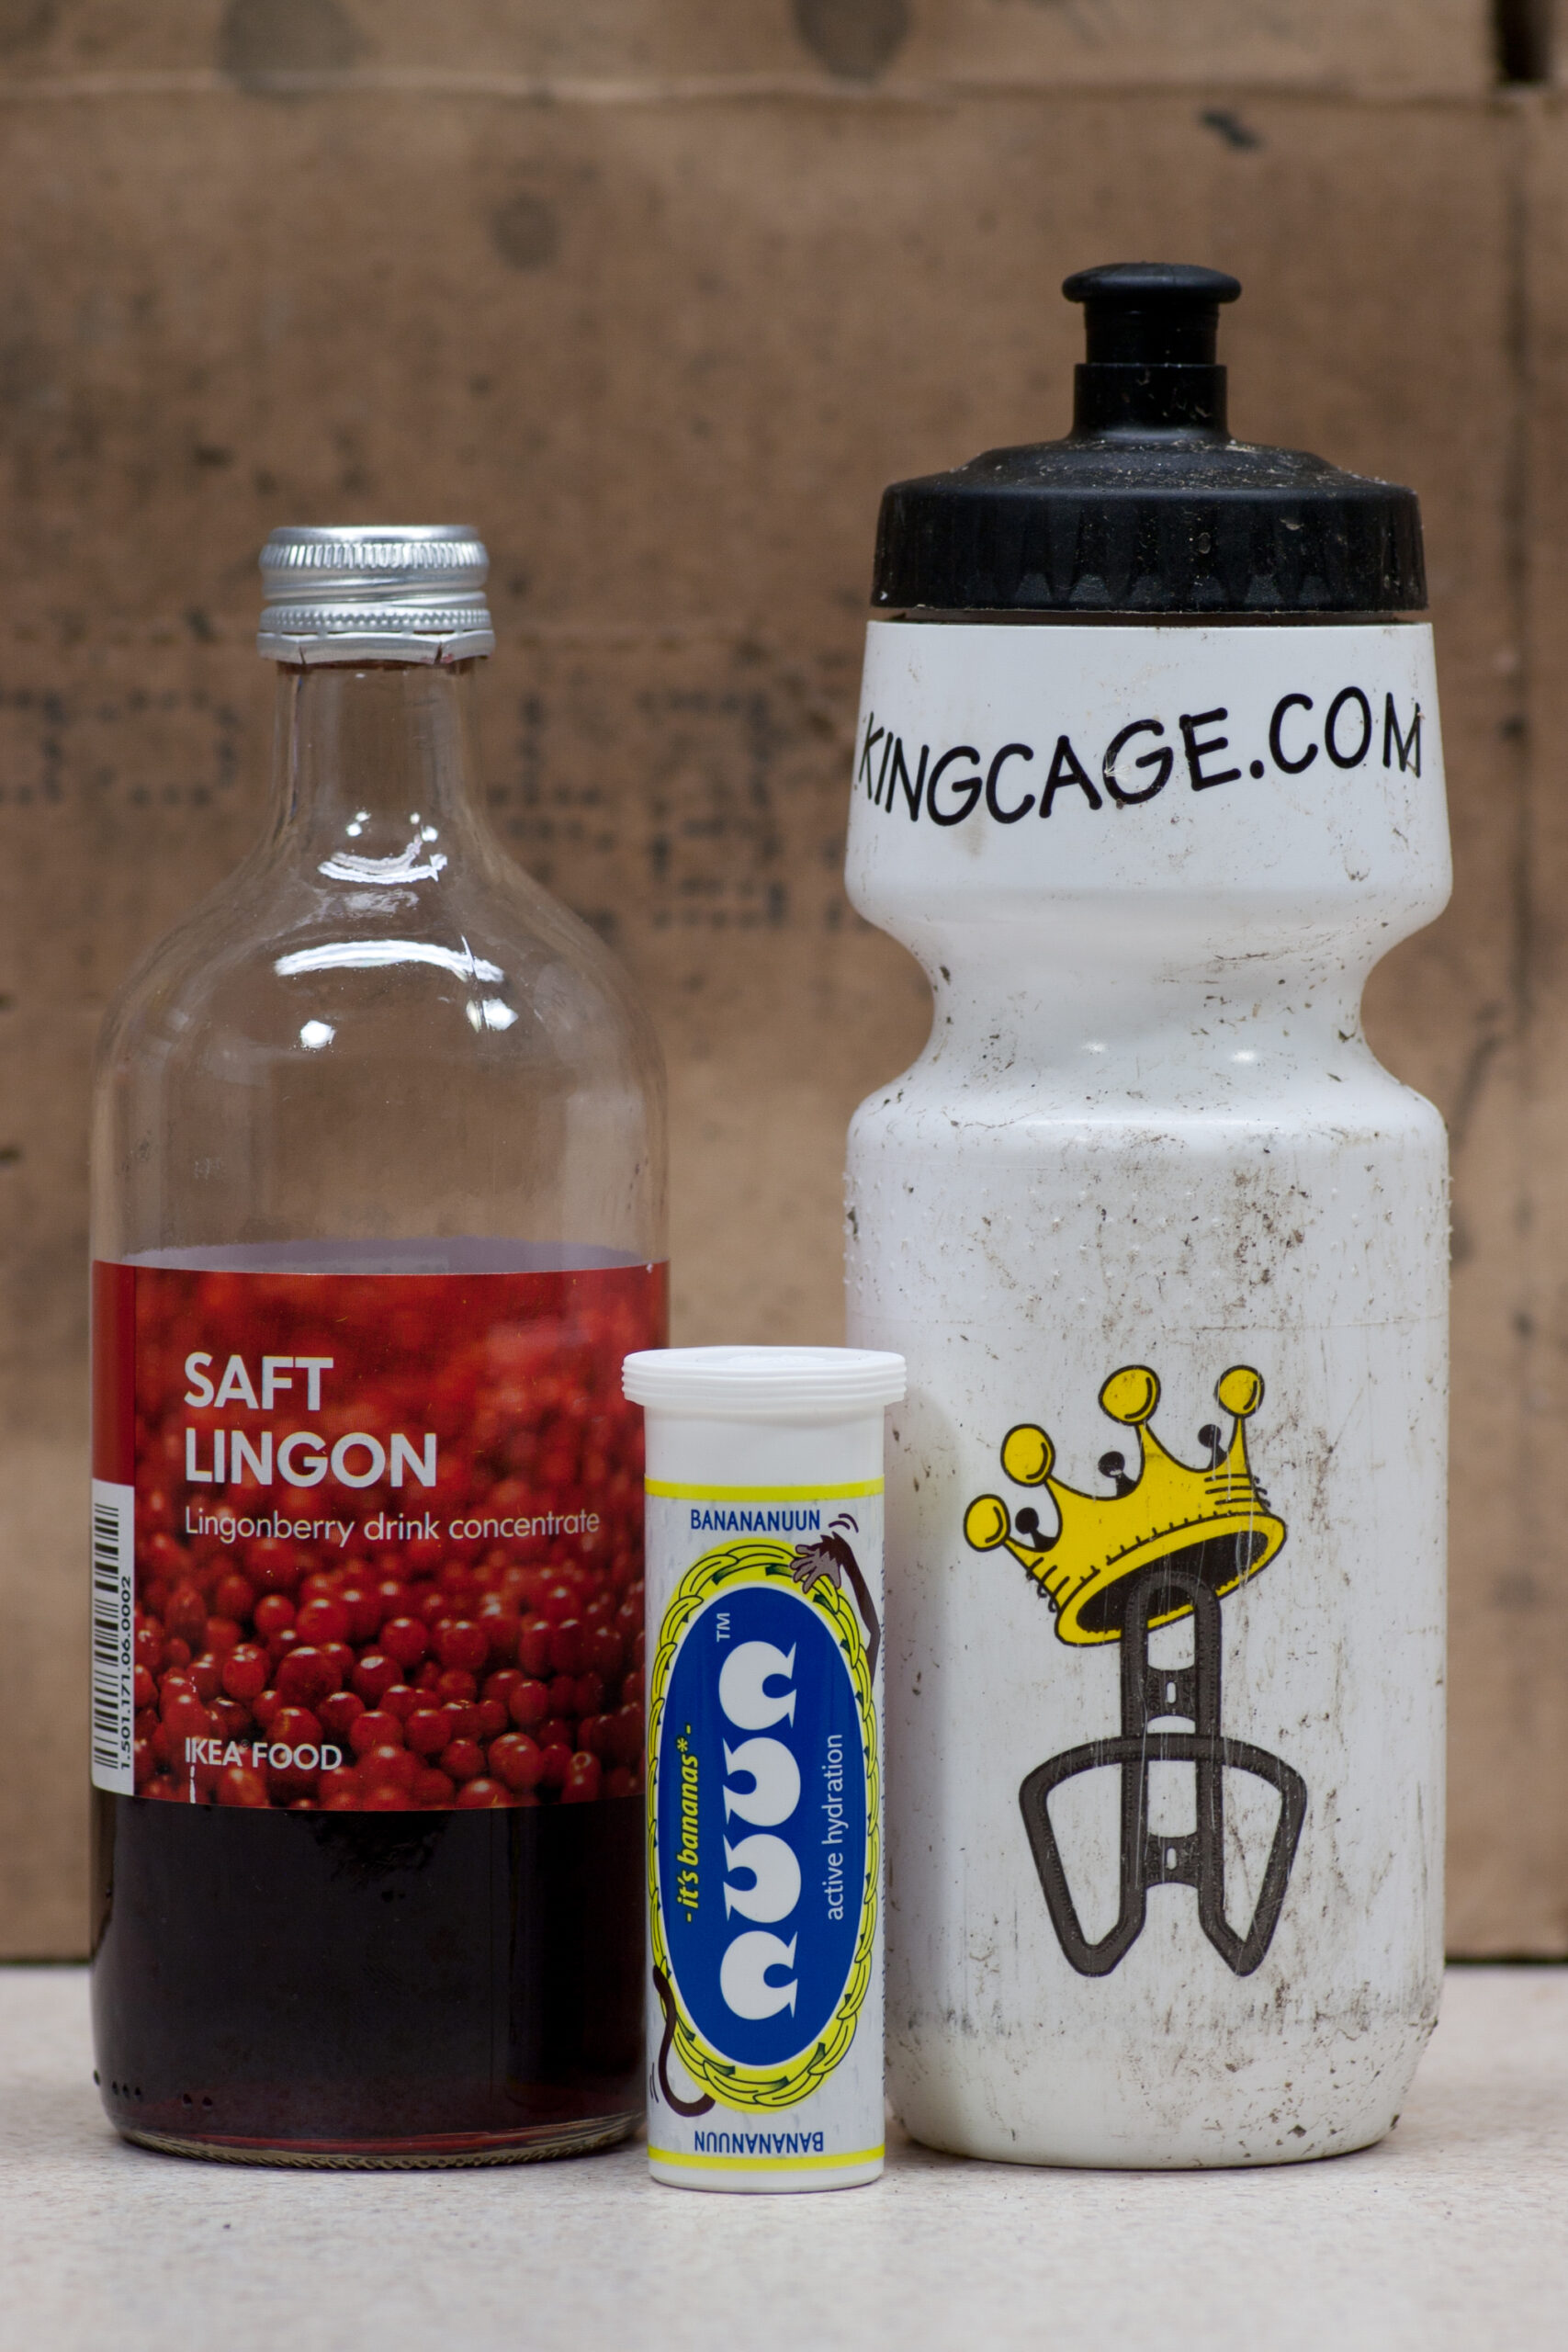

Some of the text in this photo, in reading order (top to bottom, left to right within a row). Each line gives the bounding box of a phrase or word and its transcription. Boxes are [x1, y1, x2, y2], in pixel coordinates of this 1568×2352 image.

[858, 685, 1421, 826] KINGCAGE.COM
[184, 1351, 334, 1410] SAFT
[186, 1427, 437, 1488] LINGON
[186, 1506, 600, 1548] Lingonberry drink concentrate
[691, 1509, 820, 1532] BANANANUUN
[121, 1576, 130, 1770] 1.501.171.06.0002
[185, 1736, 343, 1770] IKEA FOOD
[821, 1734, 849, 1920] active hydration
[694, 2130, 824, 2154] BANANANUUN
